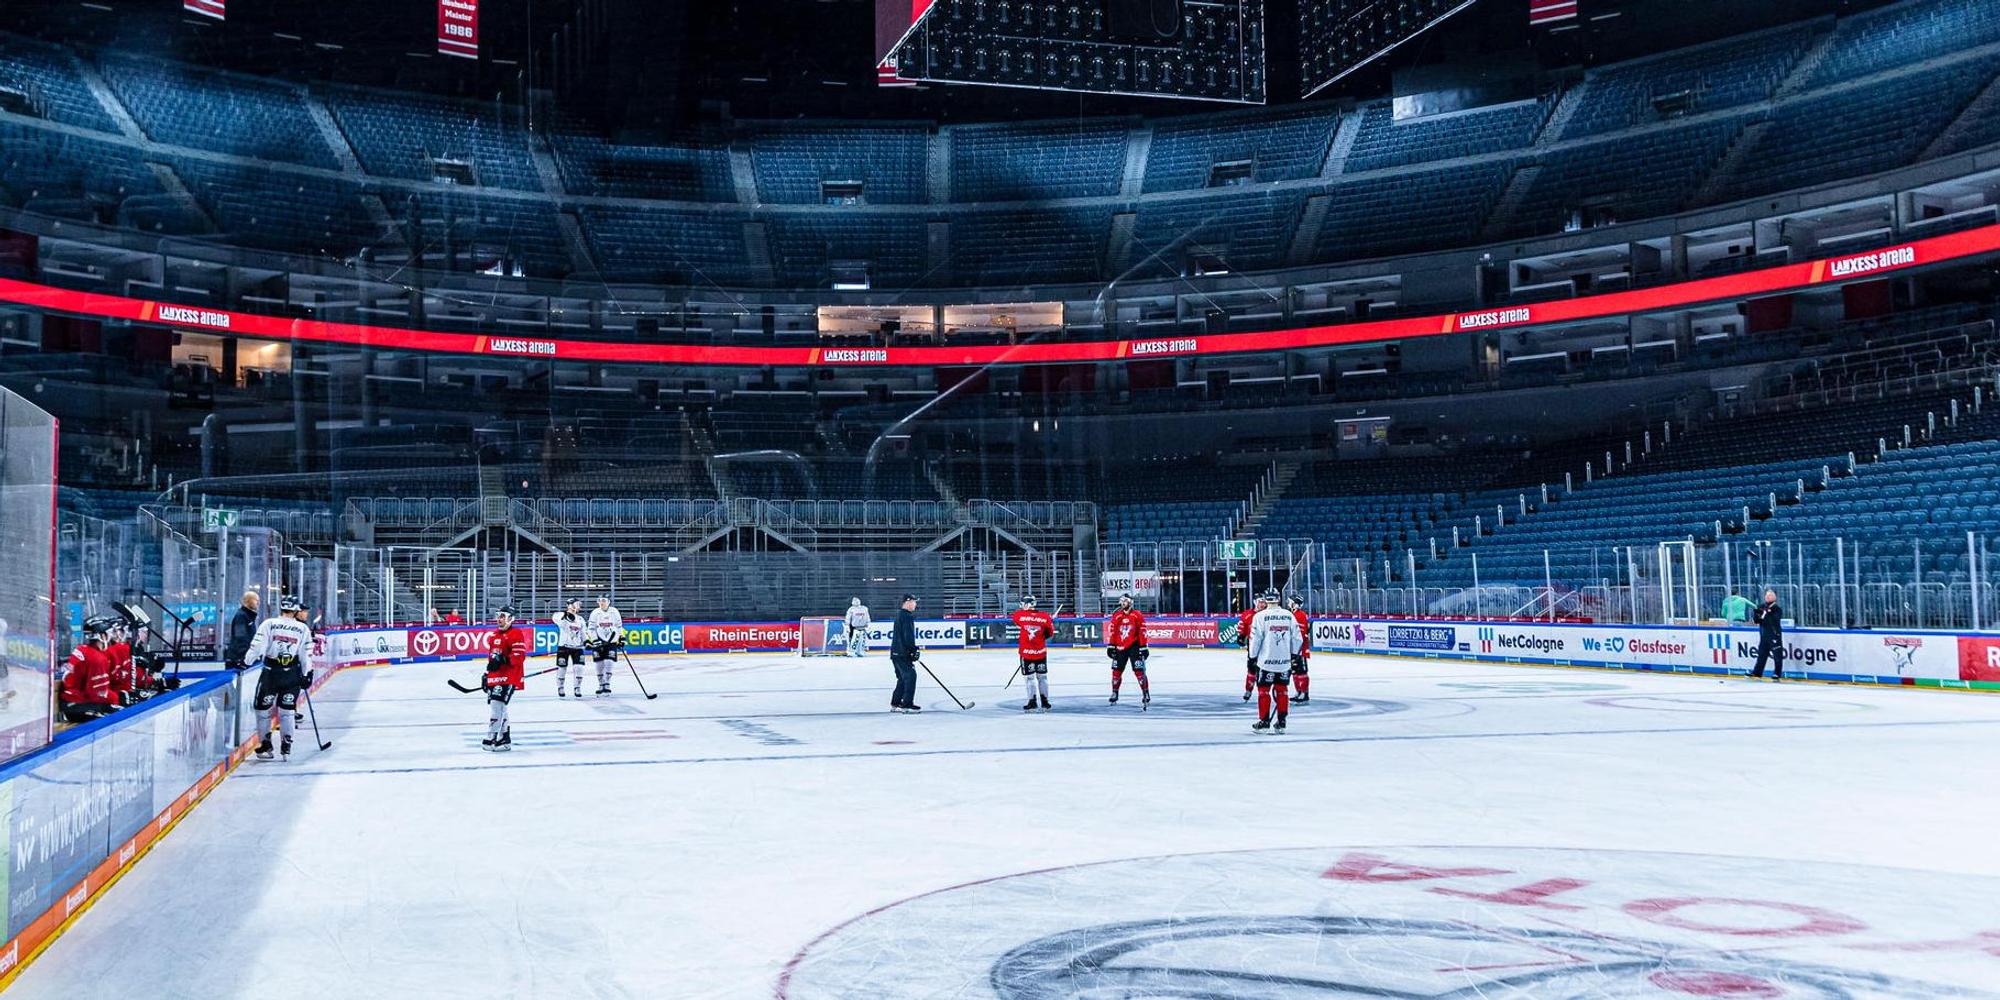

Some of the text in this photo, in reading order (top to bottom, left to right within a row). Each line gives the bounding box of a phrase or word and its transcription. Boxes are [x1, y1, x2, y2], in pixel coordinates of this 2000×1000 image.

[444, 23, 473, 38] 1986
[884, 58, 897, 68] 19
[1830, 246, 1915, 277] LANXESS arena
[159, 305, 230, 328] LANXESS arena
[1460, 308, 1530, 328] LANXESS arena
[490, 339, 556, 354] LANXESS arena
[1132, 339, 1197, 354] LANXESS arena
[823, 350, 887, 362] LANXESS arena
[709, 629, 801, 643] RheinEnergie
[1315, 624, 1351, 641] JONAS
[1424, 629, 1430, 640] &
[1430, 629, 1449, 641] BERG
[443, 632, 495, 651] TOYO
[1498, 634, 1565, 654] NetCologne
[1582, 636, 1687, 655] We Glasfaser
[1737, 641, 1838, 665] Neologne
